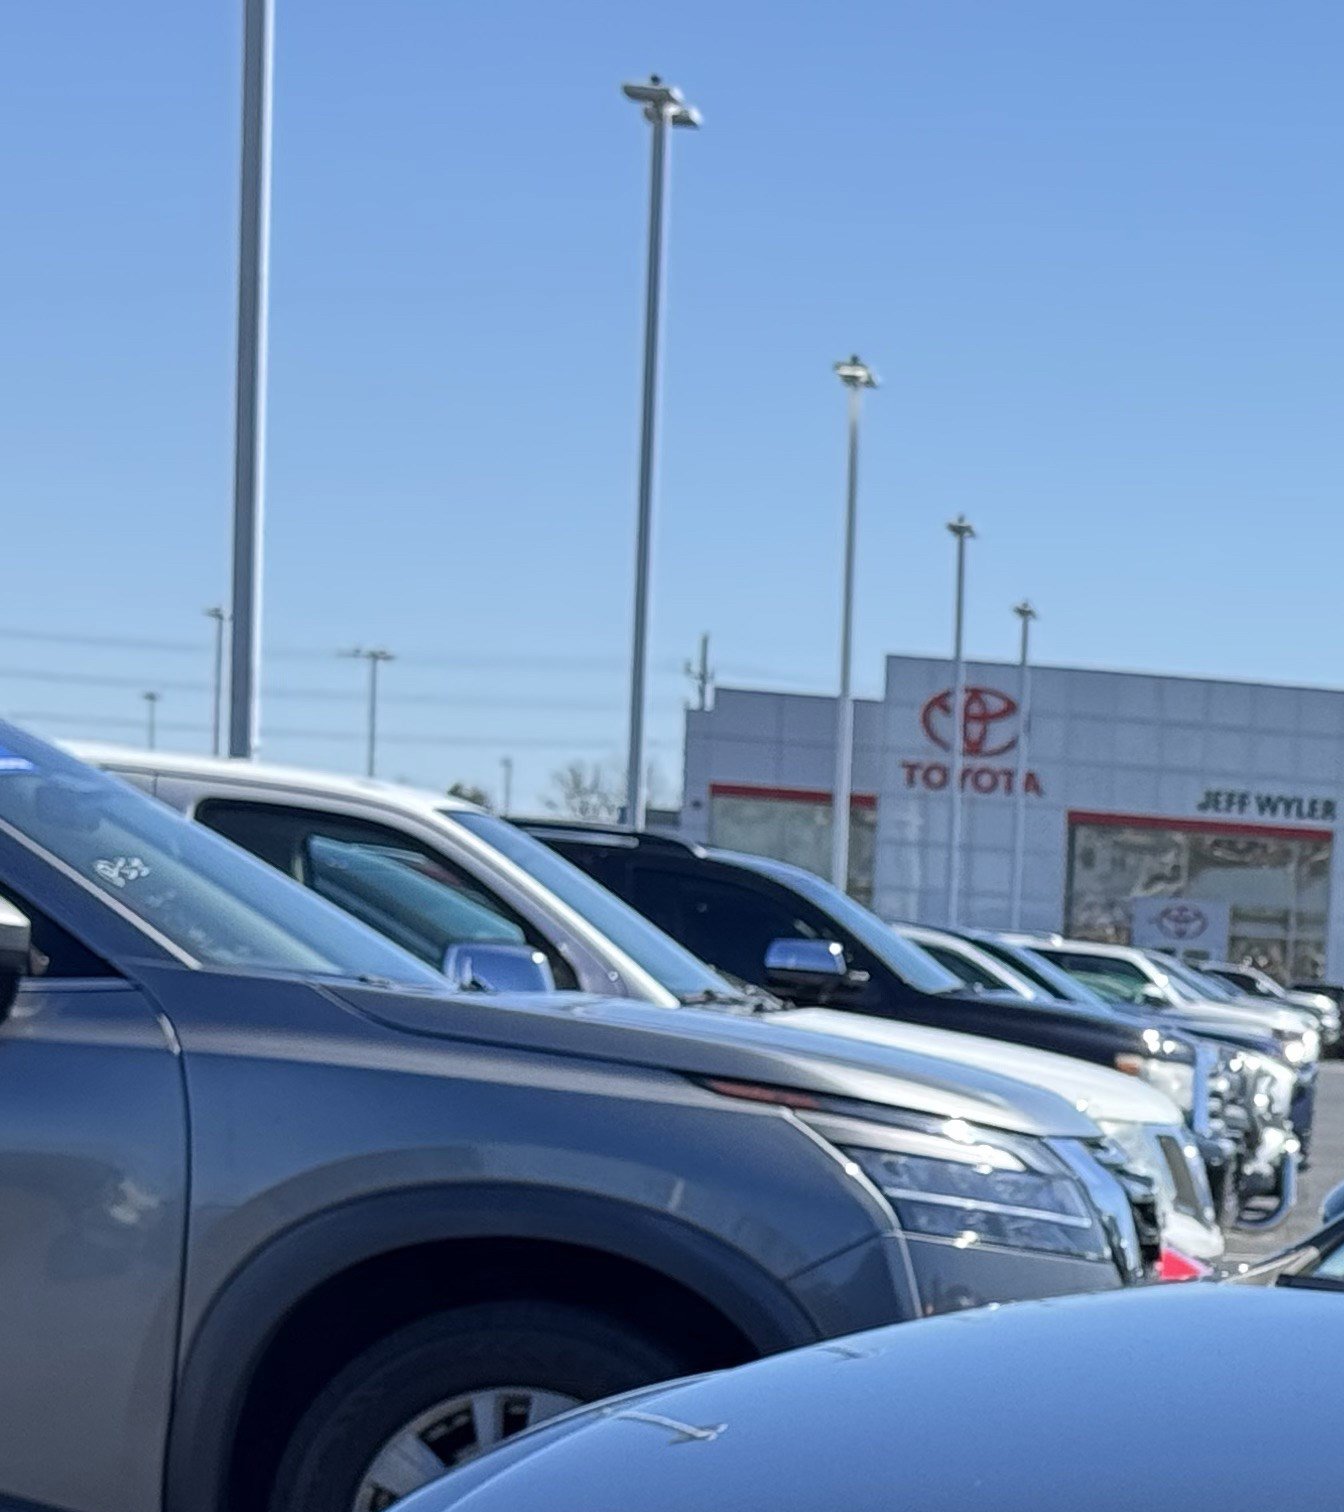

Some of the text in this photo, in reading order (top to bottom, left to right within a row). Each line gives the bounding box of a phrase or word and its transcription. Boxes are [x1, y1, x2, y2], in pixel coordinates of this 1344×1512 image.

[901, 762, 1043, 796] TOYOTA
[1197, 790, 1336, 822] JEFF WYLER
